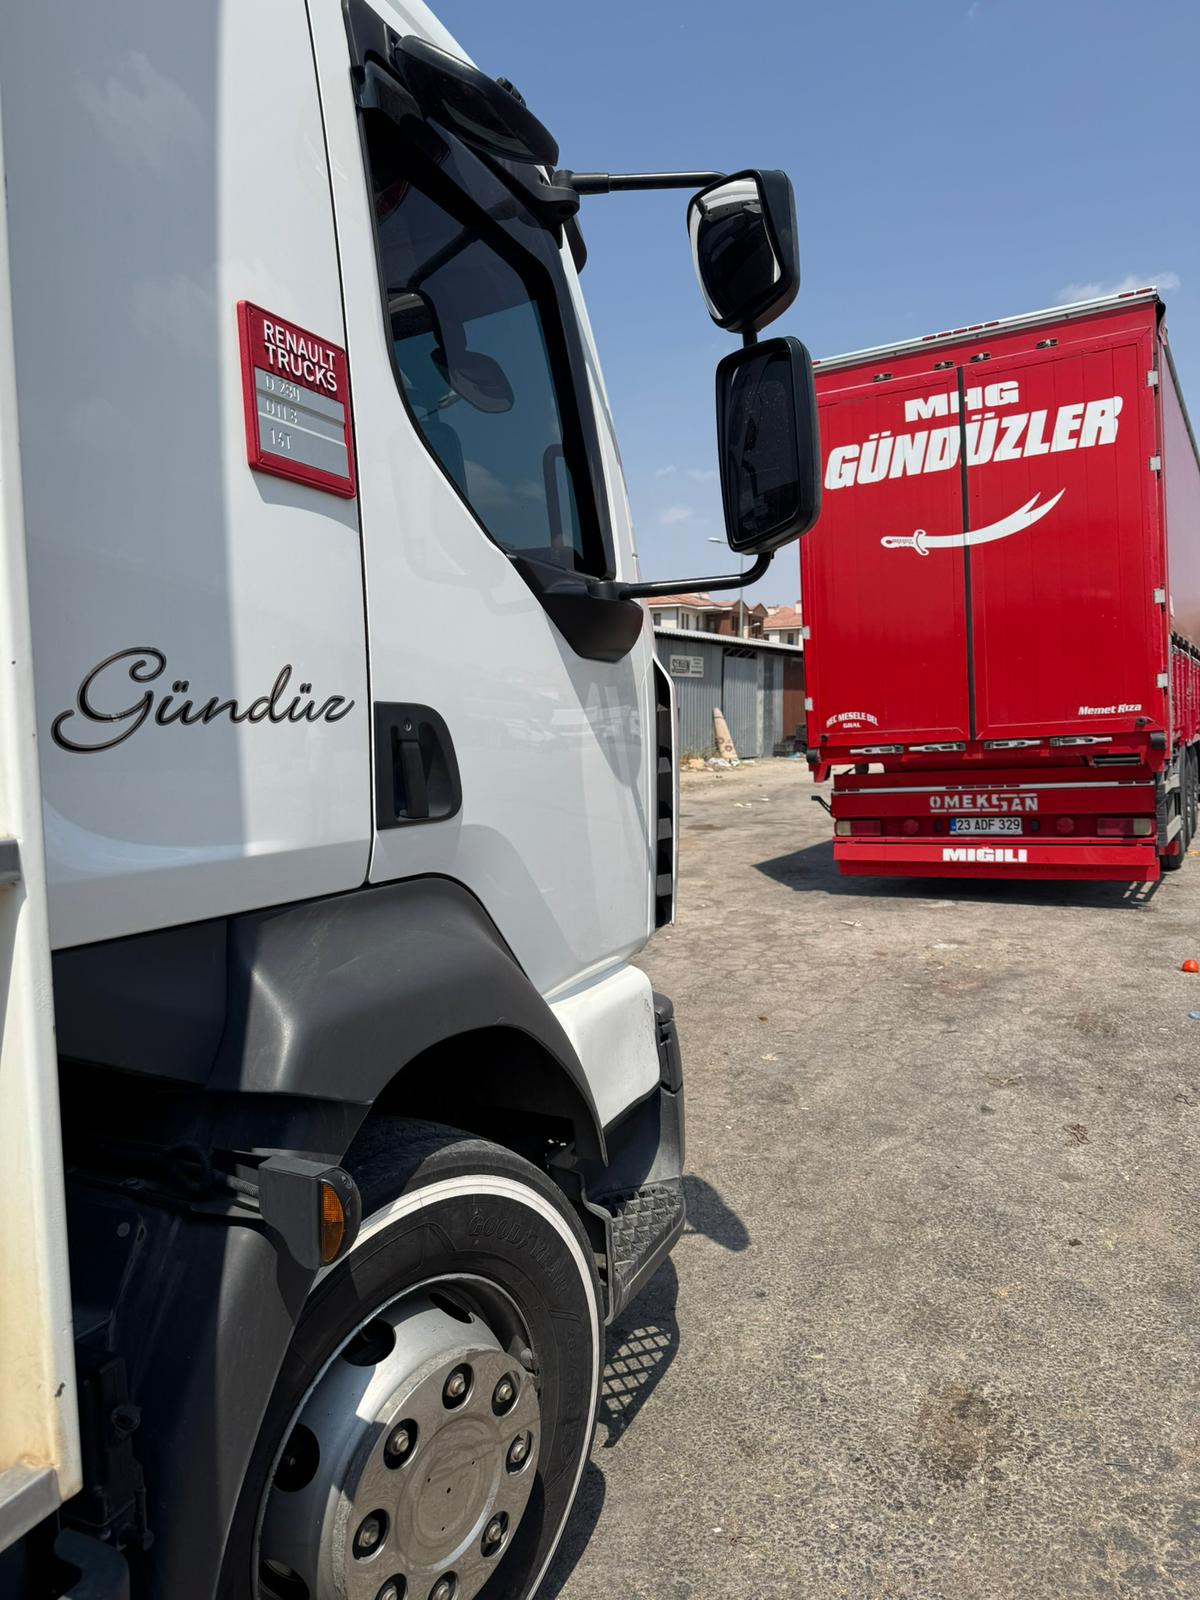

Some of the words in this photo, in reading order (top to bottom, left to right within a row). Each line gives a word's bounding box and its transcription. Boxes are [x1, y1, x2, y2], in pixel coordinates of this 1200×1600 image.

[264, 319, 335, 371] RENAULT
[265, 342, 337, 392] TRUCKS
[265, 373, 275, 391] D
[904, 380, 1020, 423] MHG
[824, 395, 1124, 490] GÜNDÜZLER
[50, 646, 355, 754] Gündüz
[1078, 705, 1117, 716] Memet
[957, 818, 971, 831] 23
[974, 818, 995, 831] ADF
[998, 818, 1020, 830] 329
